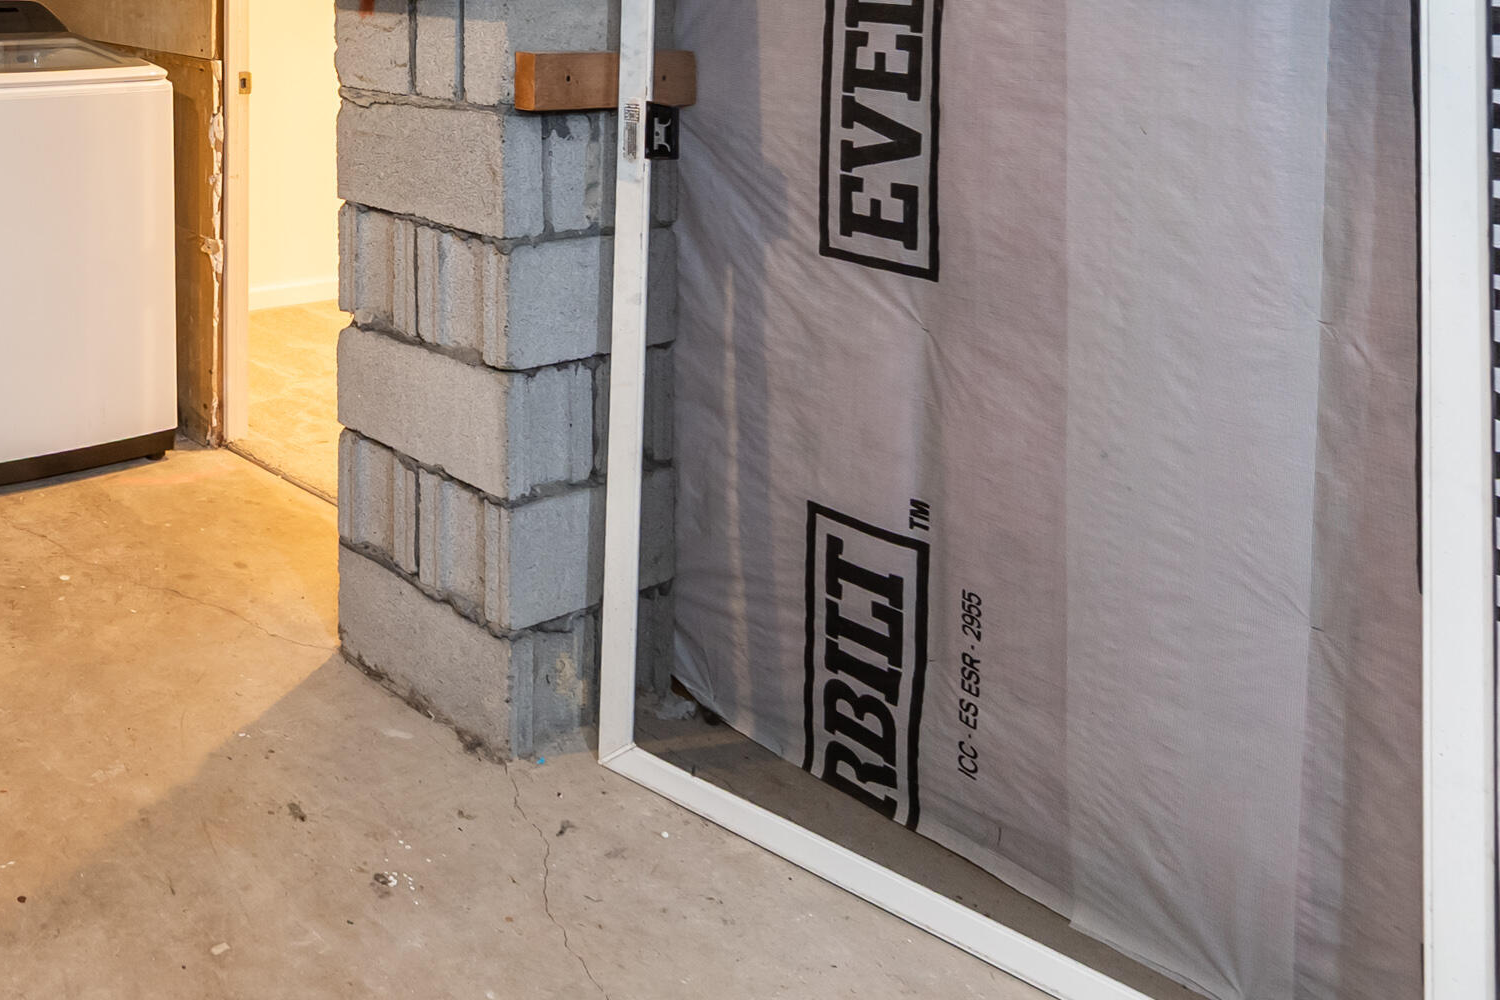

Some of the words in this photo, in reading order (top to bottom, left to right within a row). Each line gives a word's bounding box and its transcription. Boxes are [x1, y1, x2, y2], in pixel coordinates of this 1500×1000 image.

[910, 499, 931, 532] TM
[961, 589, 983, 642] 2955
[960, 651, 982, 698] ESR
[959, 699, 979, 731] ES
[958, 741, 979, 781] ICC
